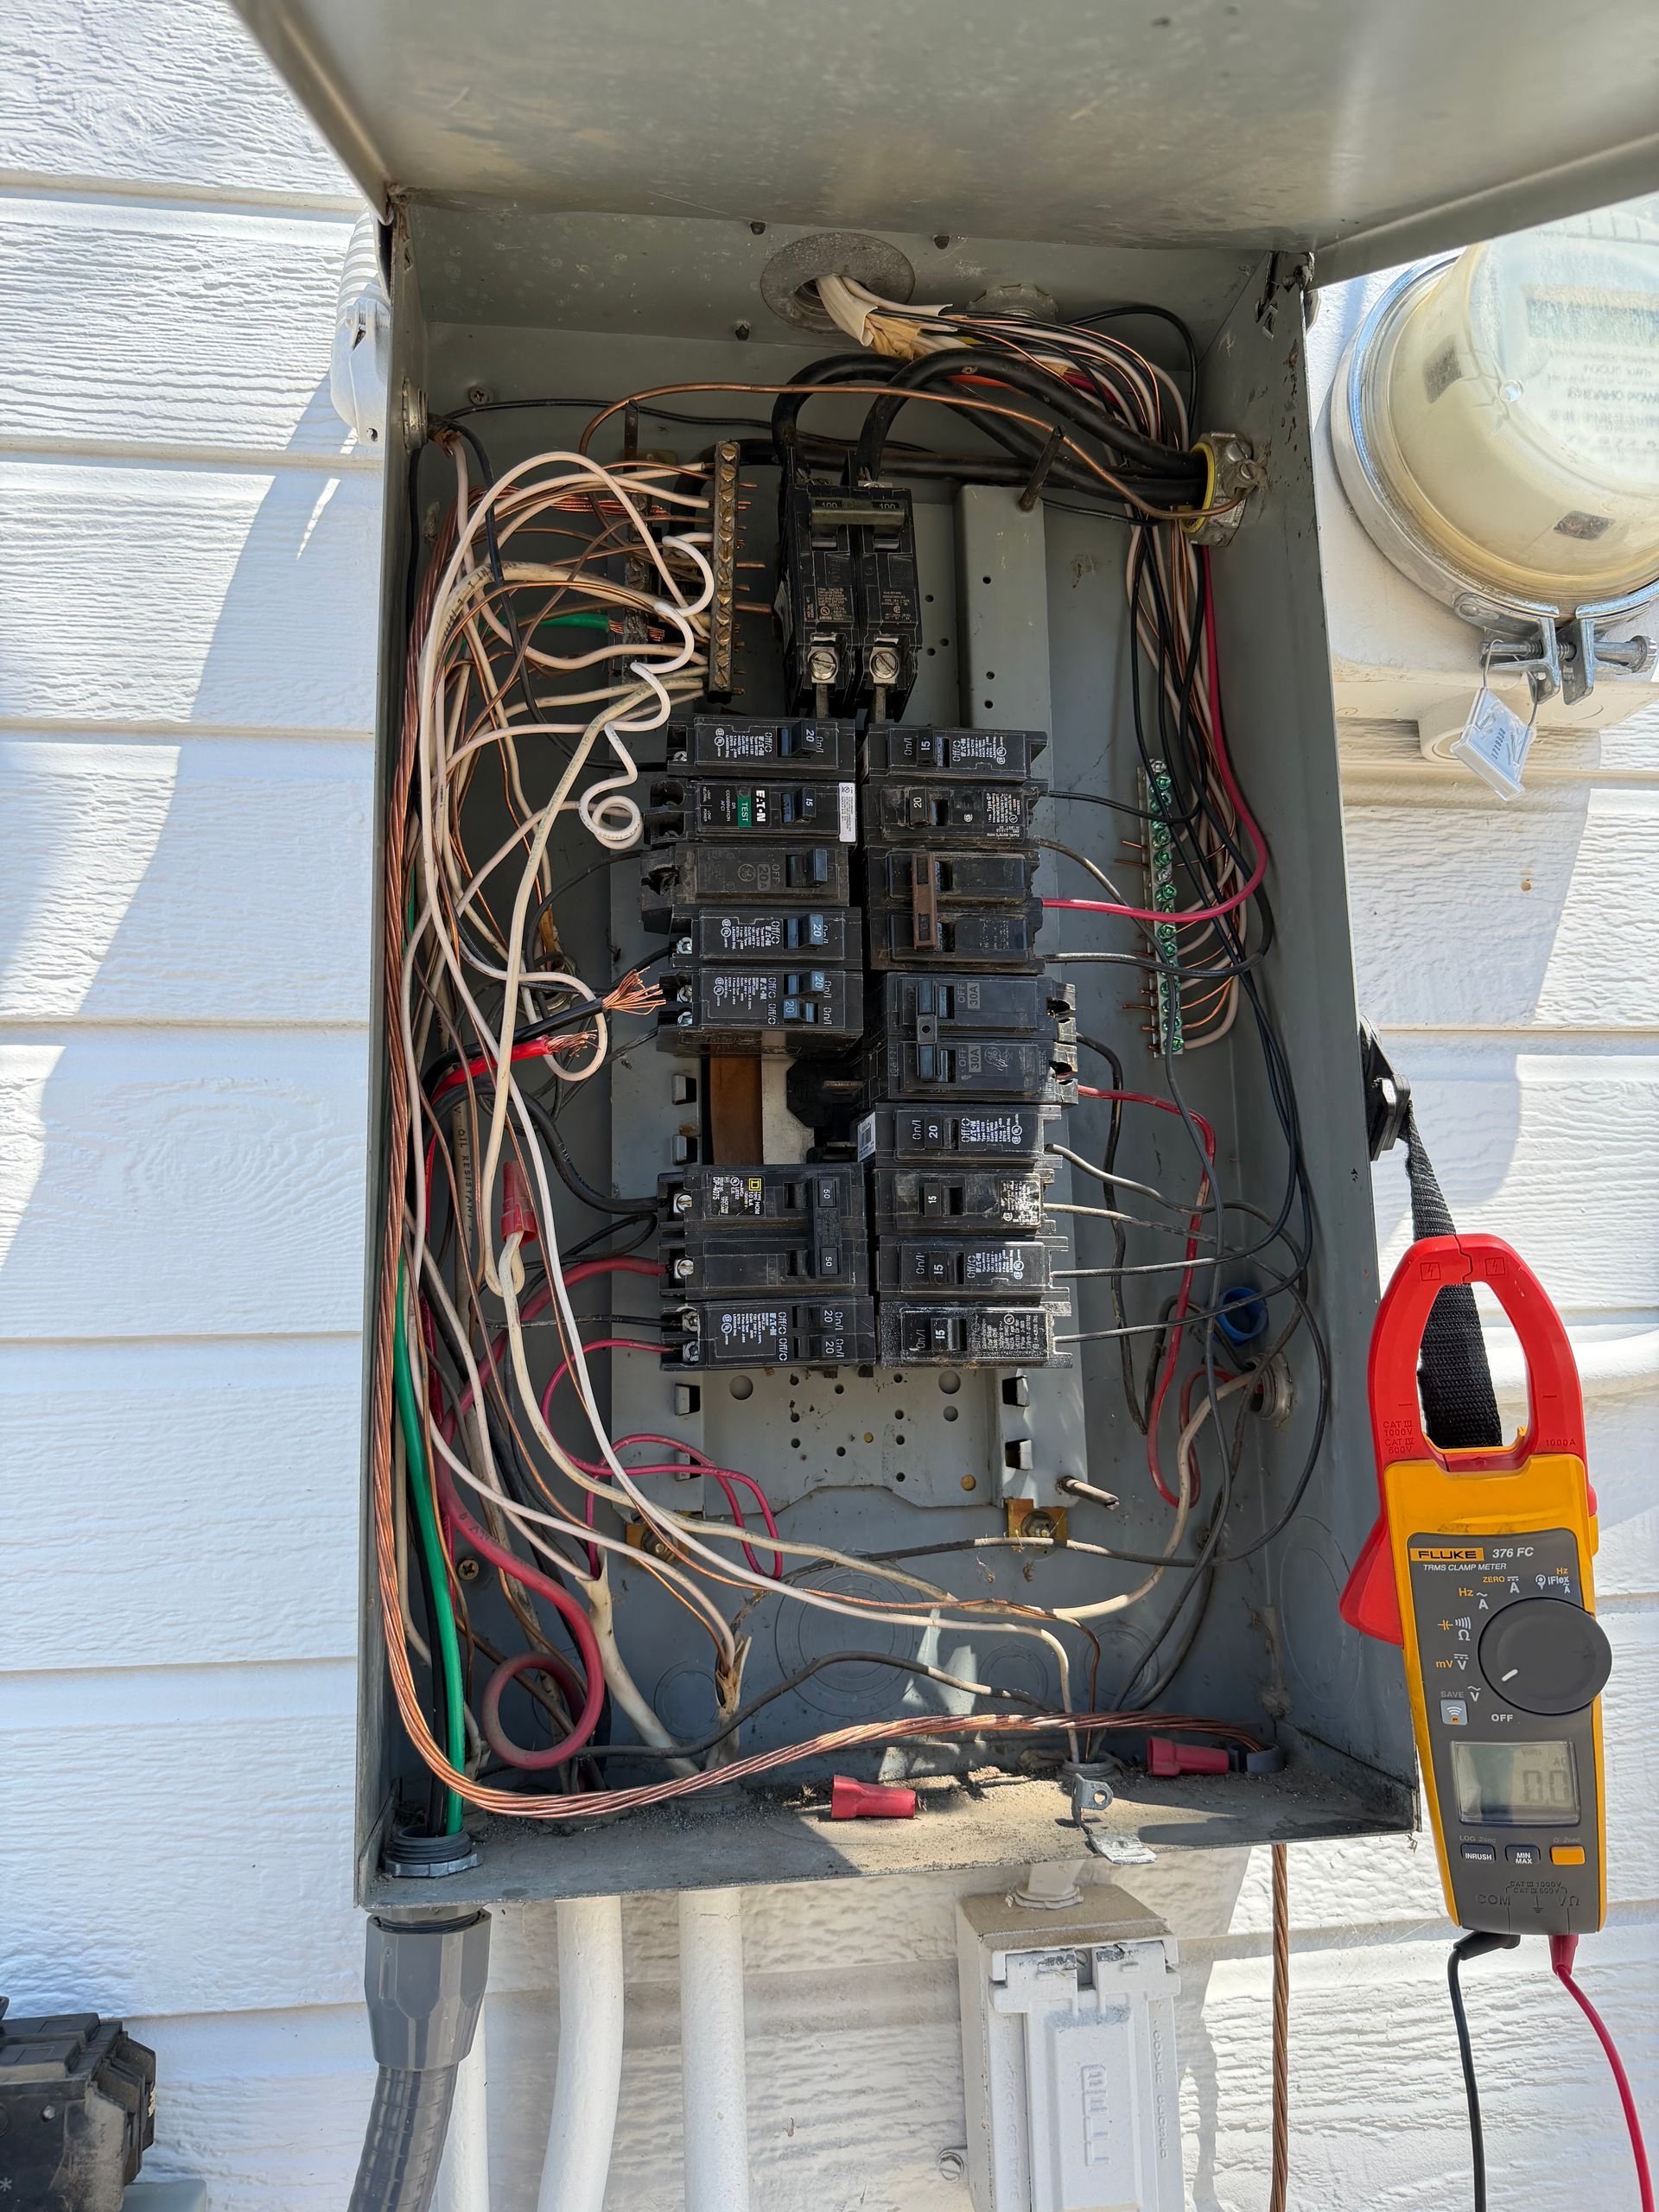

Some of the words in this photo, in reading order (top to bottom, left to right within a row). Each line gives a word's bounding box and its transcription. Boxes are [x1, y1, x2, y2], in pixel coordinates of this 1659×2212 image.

[806, 729, 814, 742] 20
[921, 741, 930, 750] 15
[913, 798, 922, 808] 20
[813, 924, 821, 937] 20
[815, 976, 823, 988] 20
[969, 985, 978, 1006] 30A
[785, 1001, 794, 1013] 20
[970, 1049, 979, 1069] 30A
[929, 1125, 938, 1139] 20
[823, 1189, 830, 1198] 50
[825, 1256, 832, 1267] 50
[934, 1264, 943, 1274] 15
[824, 1310, 833, 1323] 20
[936, 1330, 945, 1338] 15
[826, 1341, 834, 1354] 20
[1418, 1550, 1478, 1560] FLUKE
[1492, 1548, 1515, 1559] 376
[1516, 1546, 1535, 1556] FC
[1448, 1562, 1476, 1572] CLAMP
[1478, 1562, 1507, 1571] METER
[1459, 1588, 1474, 1597] Hz
[1435, 1659, 1453, 1669] mV
[1491, 1713, 1514, 1722] OFF
[1478, 1894, 1510, 1905] COM
[1081, 2064, 1111, 2166] BELL
